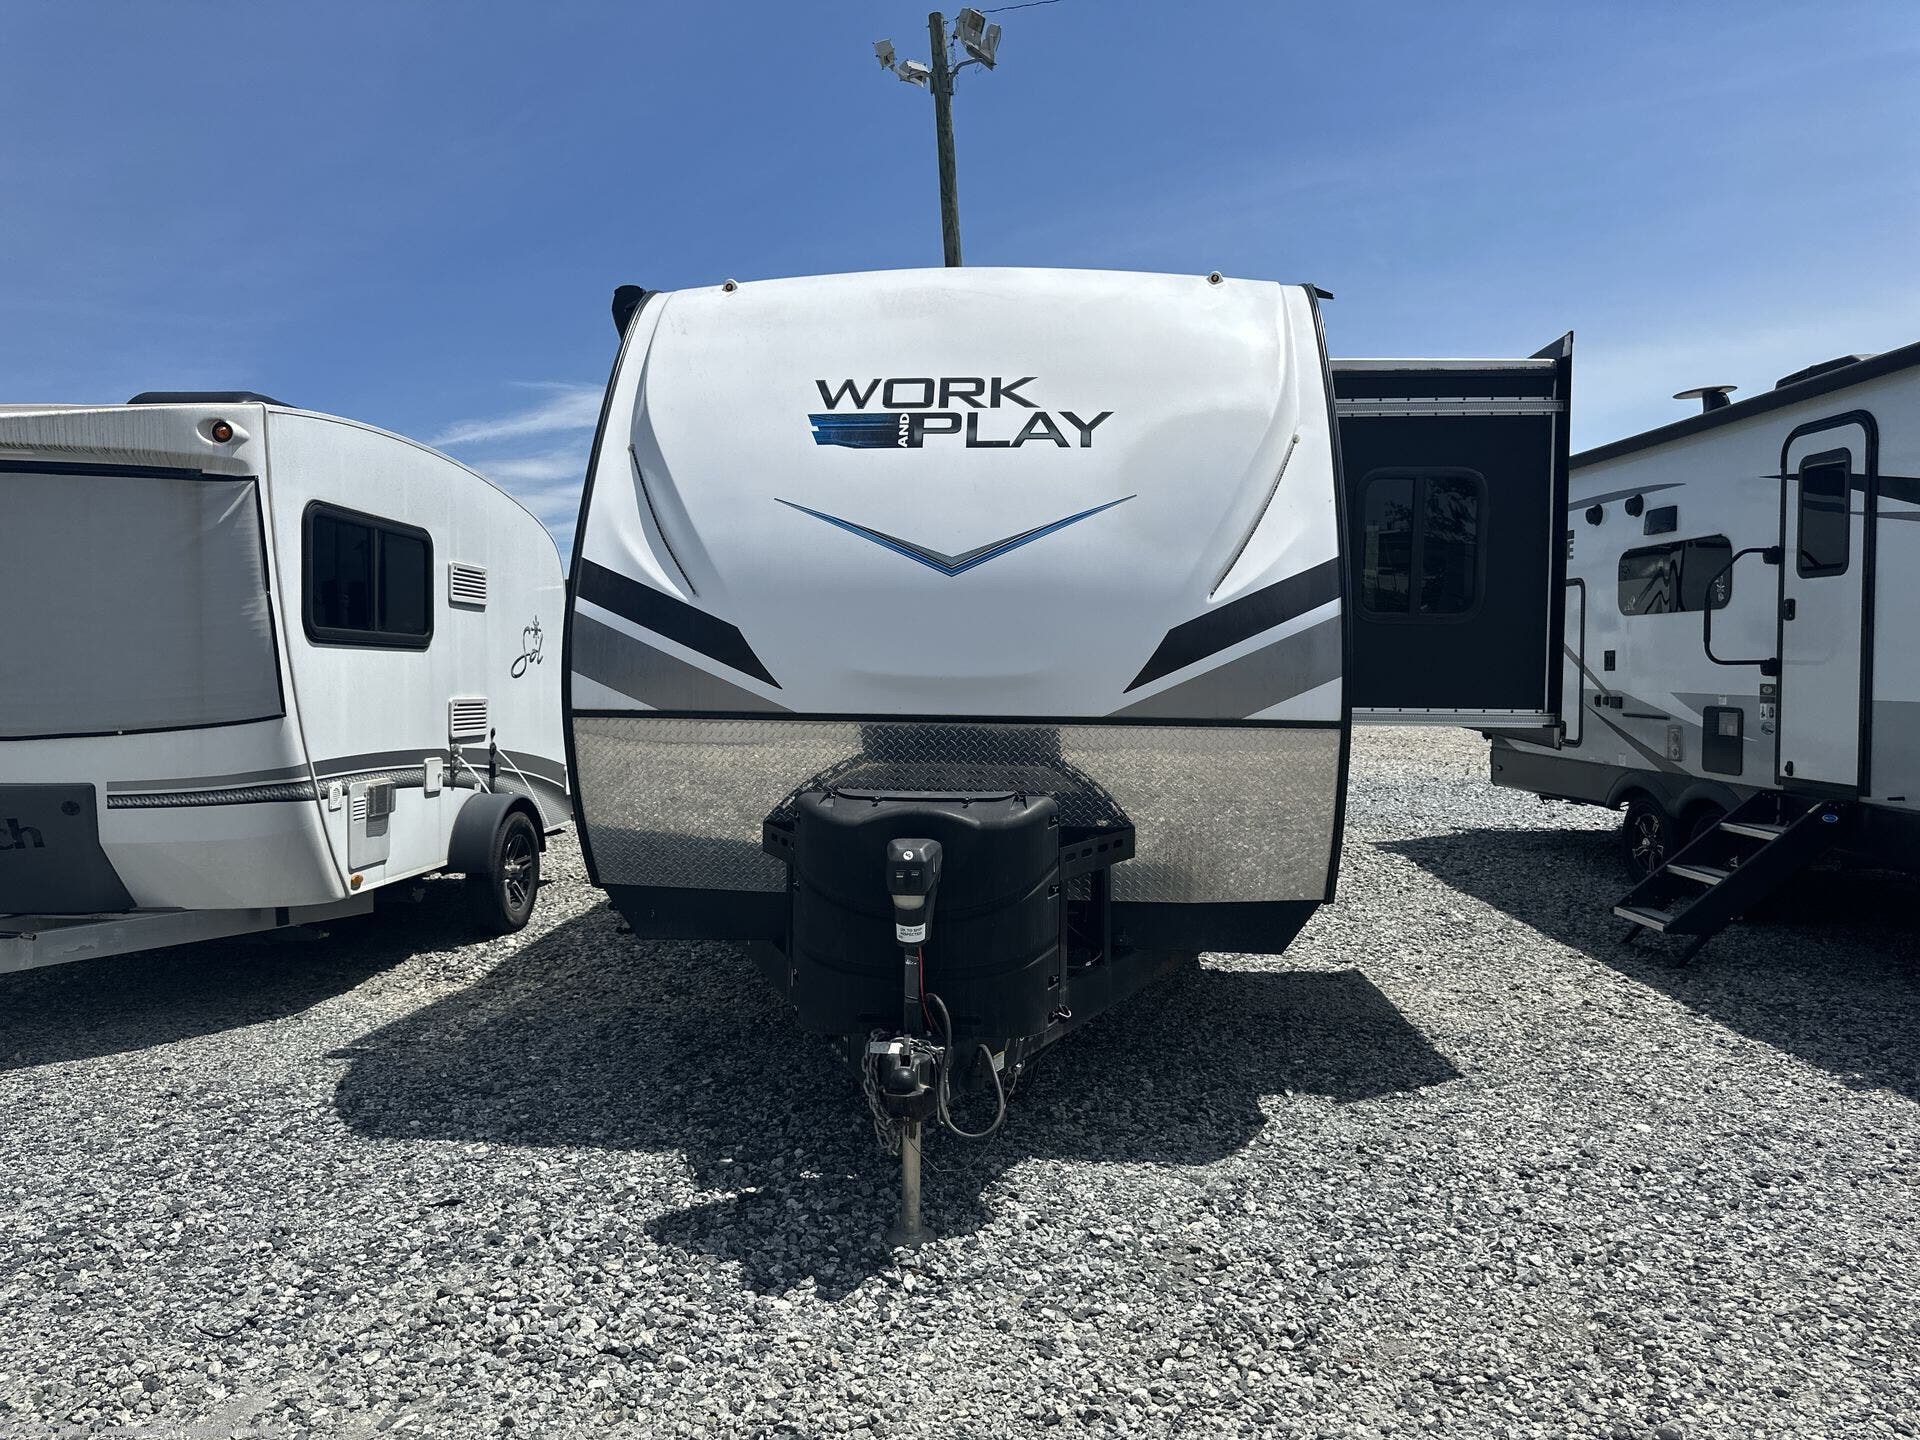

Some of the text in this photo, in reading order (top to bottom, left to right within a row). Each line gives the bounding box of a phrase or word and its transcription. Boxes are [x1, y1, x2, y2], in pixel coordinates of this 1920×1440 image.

[815, 376, 1041, 410] WORK
[897, 413, 909, 447] AND
[912, 411, 1114, 448] PLAY
